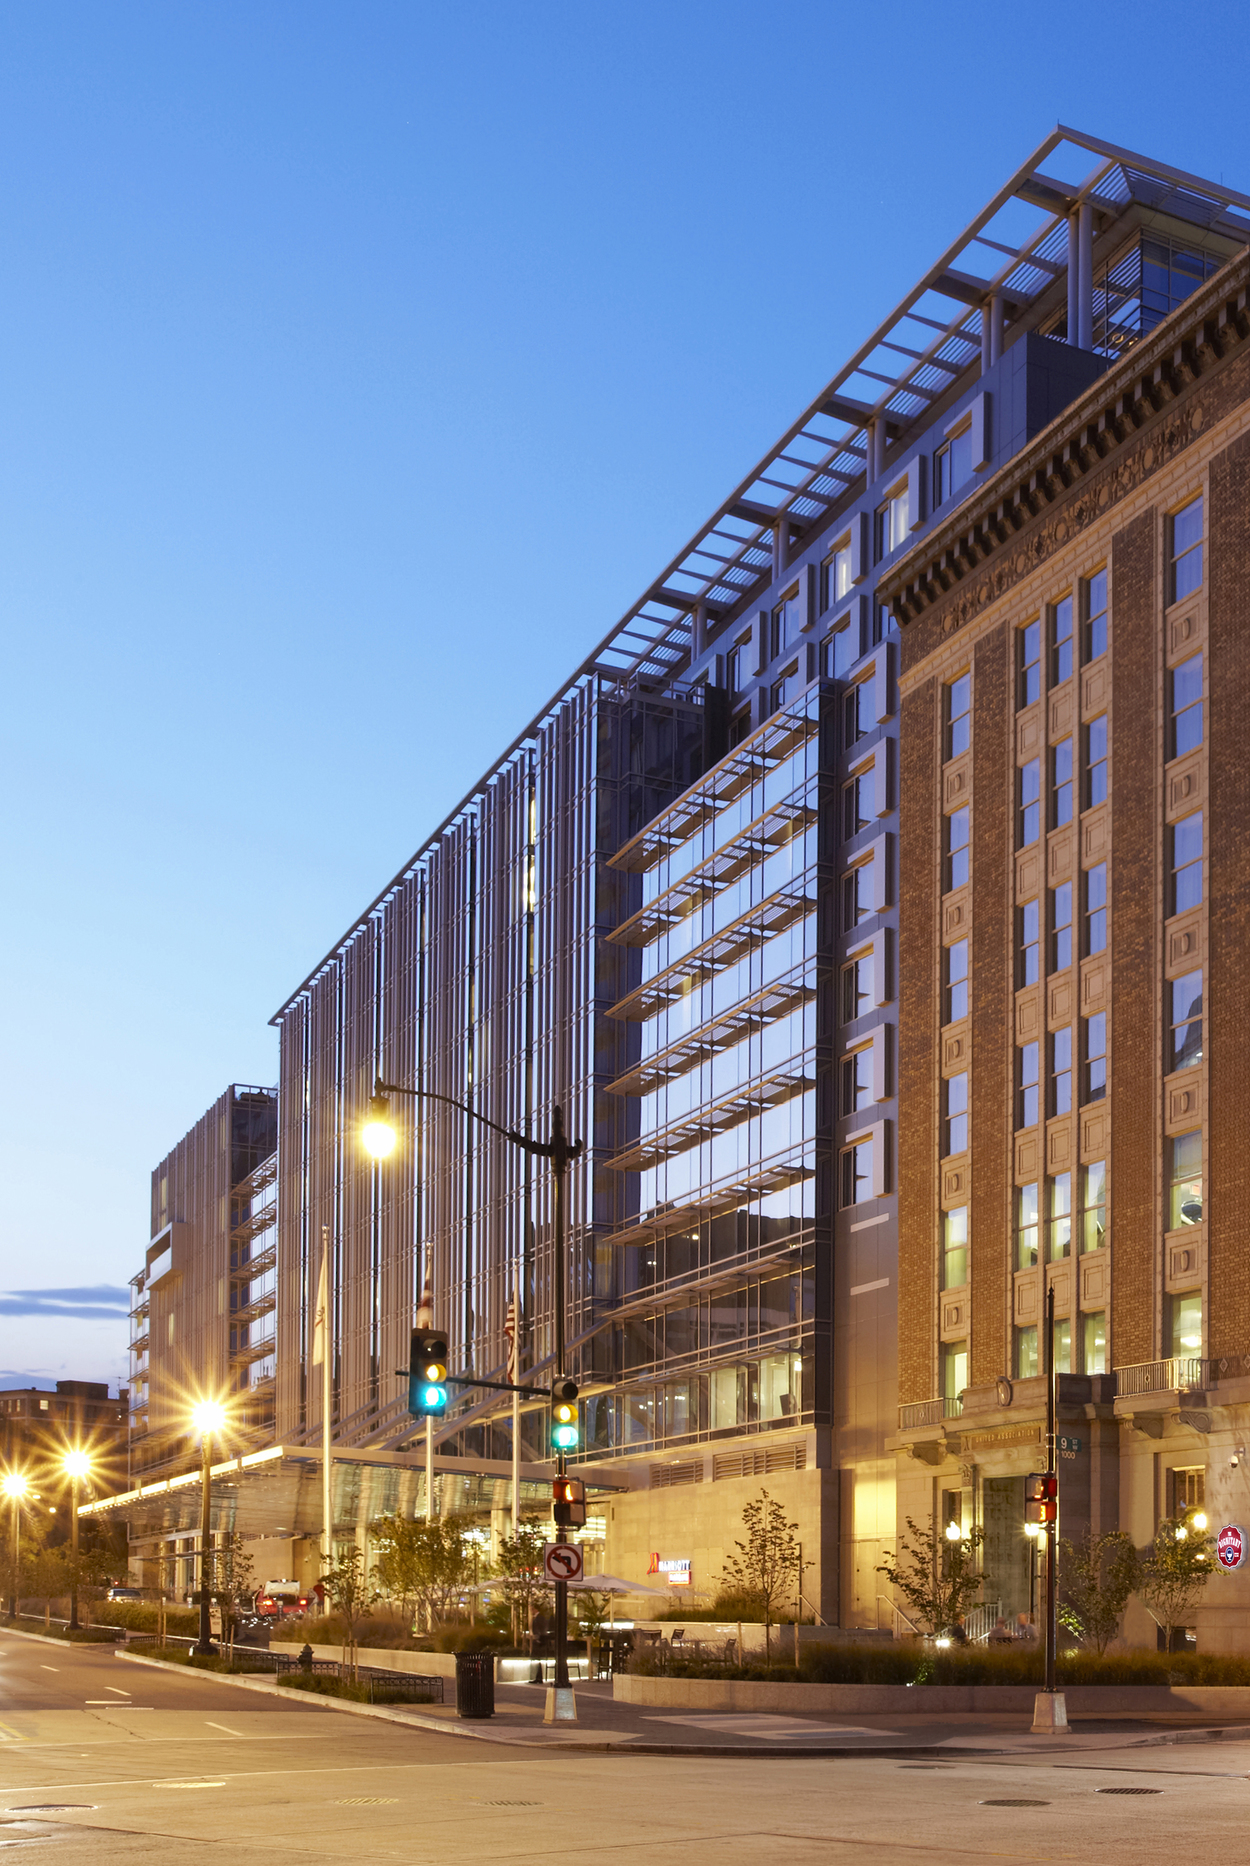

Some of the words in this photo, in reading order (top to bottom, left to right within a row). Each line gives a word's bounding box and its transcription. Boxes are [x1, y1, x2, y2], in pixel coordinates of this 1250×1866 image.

[975, 1434, 995, 1443] UNITED
[997, 1429, 1035, 1440] ASSOCIATION
[1060, 1437, 1068, 1449] 9
[1061, 1450, 1076, 1460] 1000
